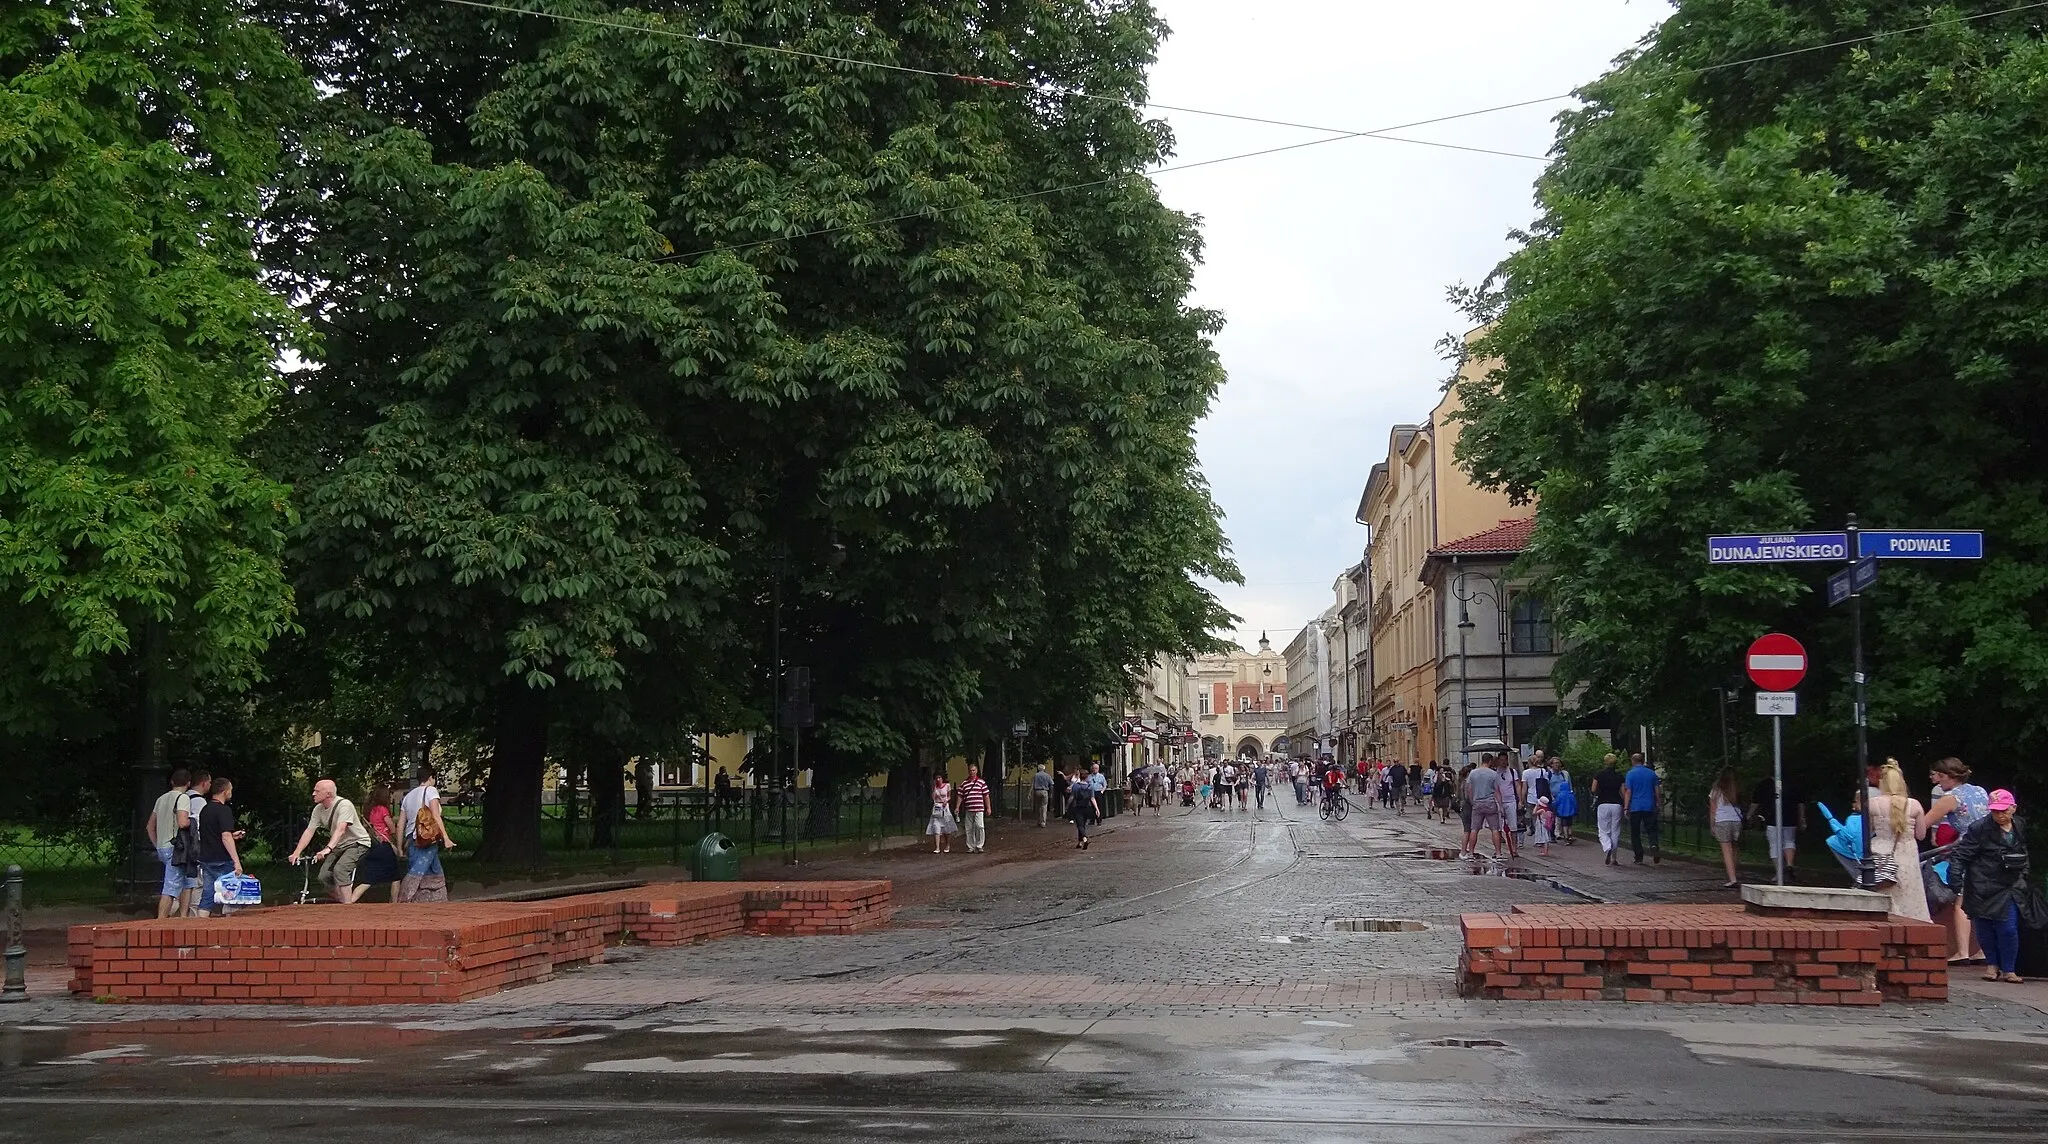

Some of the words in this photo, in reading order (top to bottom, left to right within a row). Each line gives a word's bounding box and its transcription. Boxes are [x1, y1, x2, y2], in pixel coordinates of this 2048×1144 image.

[1759, 536, 1796, 544] JULIANA
[1889, 538, 1951, 552] PODWALE
[1712, 544, 1844, 561] DUNAJEWSKIEGO
